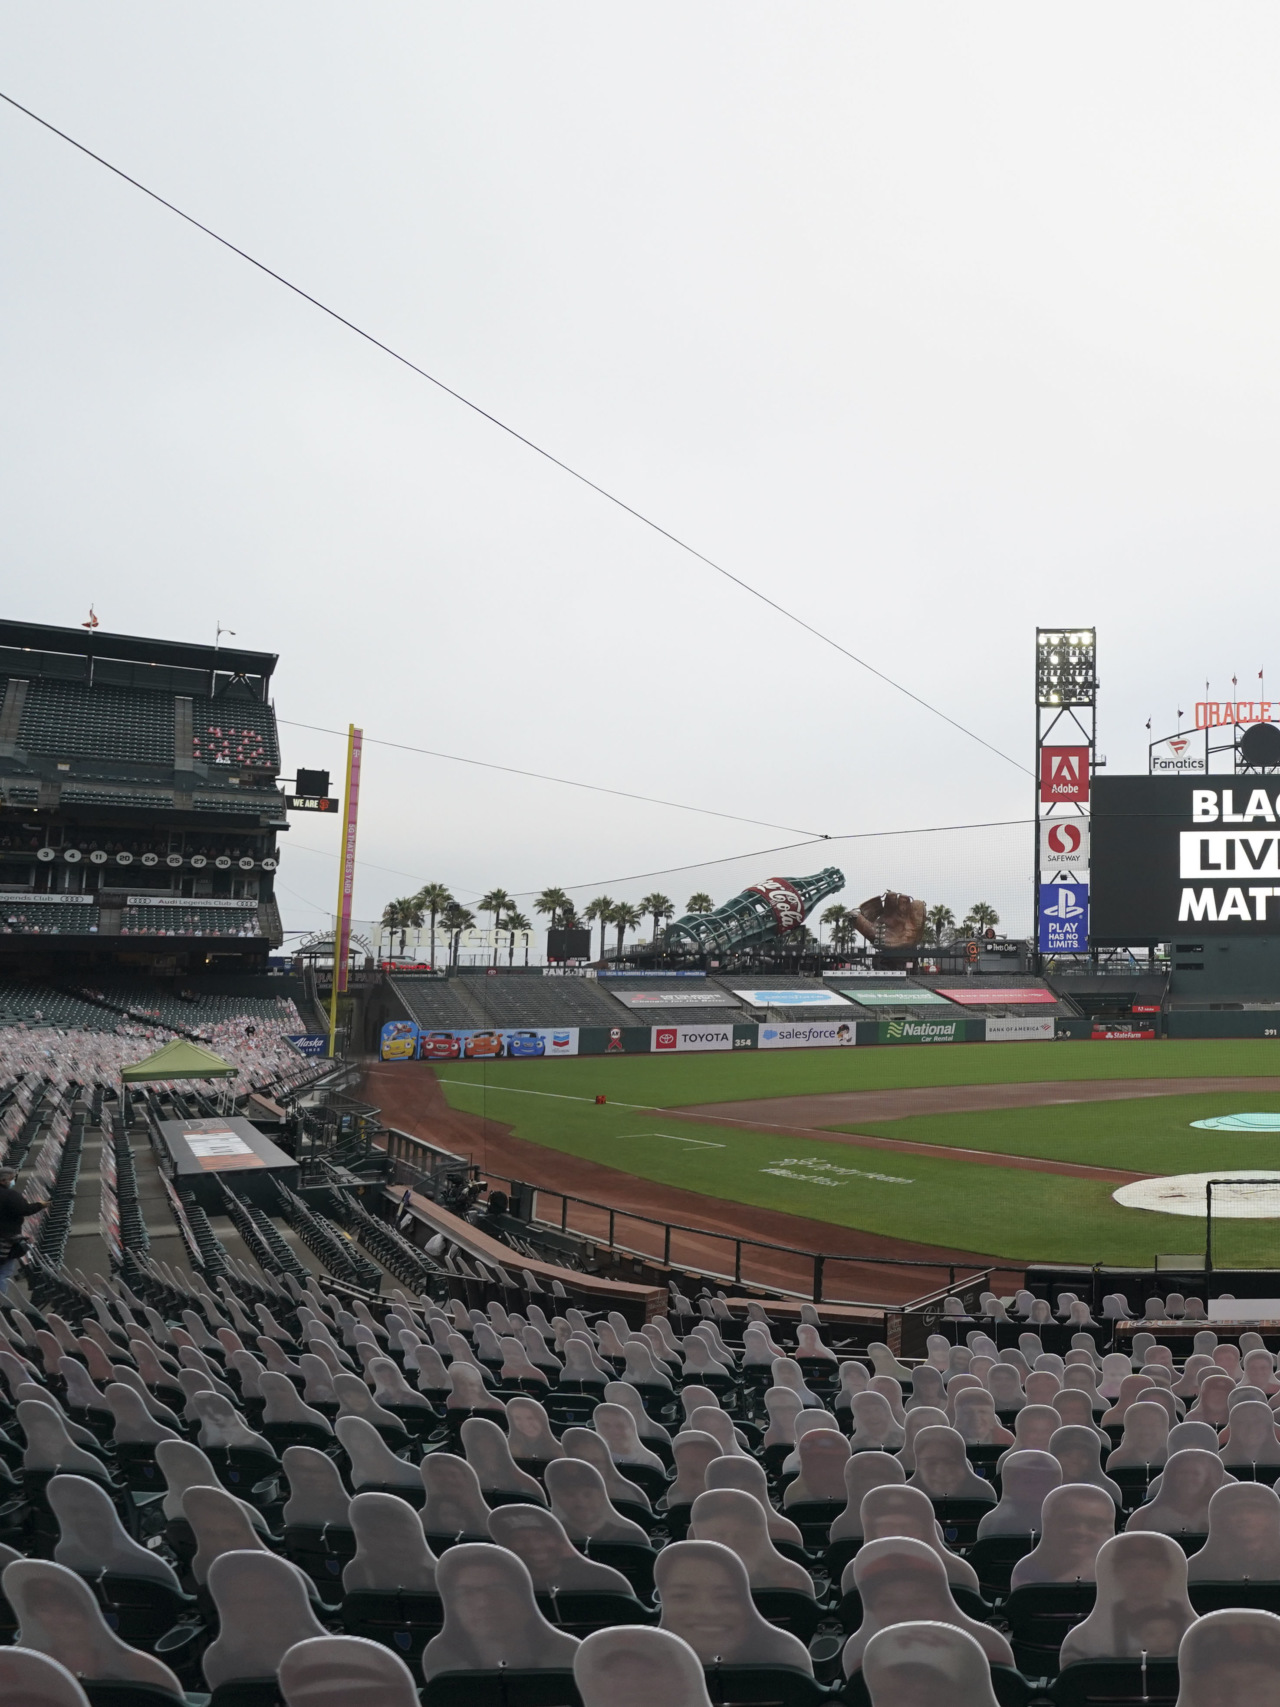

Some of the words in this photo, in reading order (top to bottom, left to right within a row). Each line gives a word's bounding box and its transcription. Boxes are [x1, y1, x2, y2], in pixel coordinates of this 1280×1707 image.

[1195, 702, 1271, 730] ORACLE
[1152, 757, 1204, 769] Fanatics
[1051, 784, 1078, 794] Adobe
[293, 799, 304, 807] WE
[305, 800, 318, 808] ARE
[1047, 854, 1080, 862] SAFEWAY
[345, 854, 353, 873] GOES
[344, 875, 352, 894] YARD
[1049, 923, 1078, 933] PLAY
[371, 927, 537, 948] nuveen
[543, 968, 564, 976] FAN
[903, 1022, 956, 1036] National
[682, 1033, 729, 1043] TOYOTA
[778, 1028, 836, 1041] salesforce
[294, 1037, 323, 1047] Alaska
[735, 1039, 751, 1047] 354
